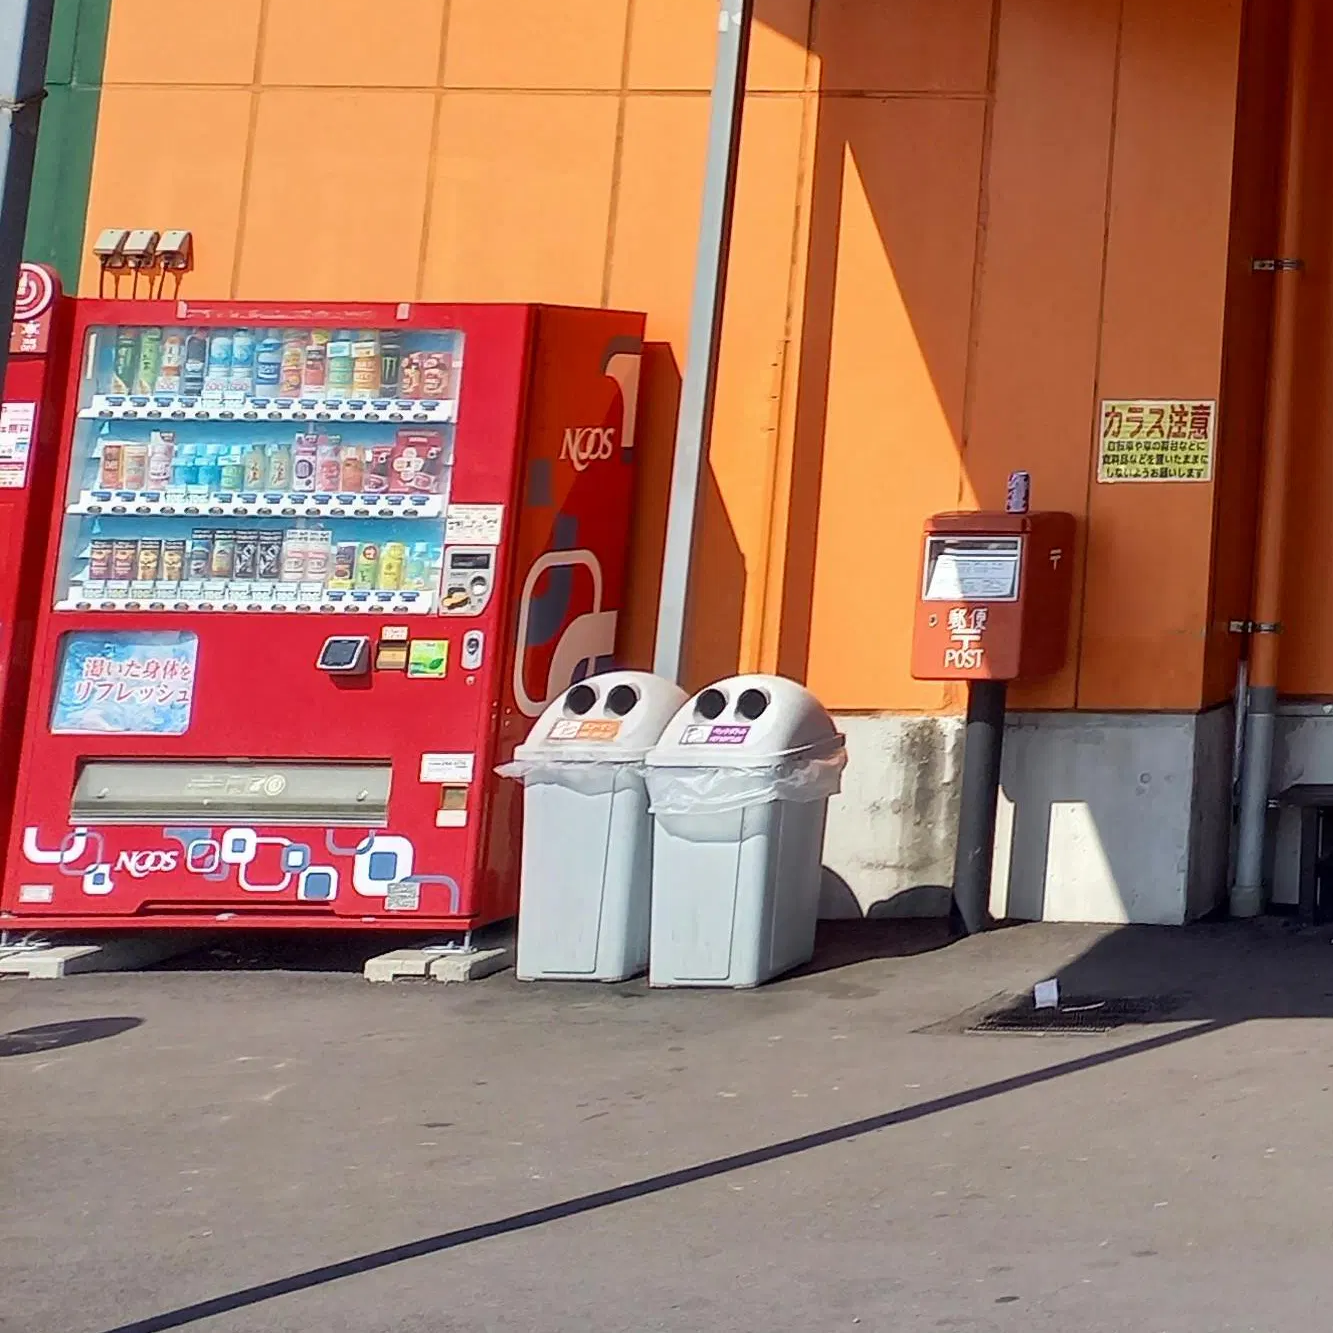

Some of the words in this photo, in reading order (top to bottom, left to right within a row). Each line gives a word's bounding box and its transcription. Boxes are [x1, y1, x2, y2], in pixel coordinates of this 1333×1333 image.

[1103, 404, 1211, 440] カラス注意
[947, 608, 988, 631] 郵便
[944, 649, 984, 669] POST
[76, 681, 189, 702] リフレッシュ
